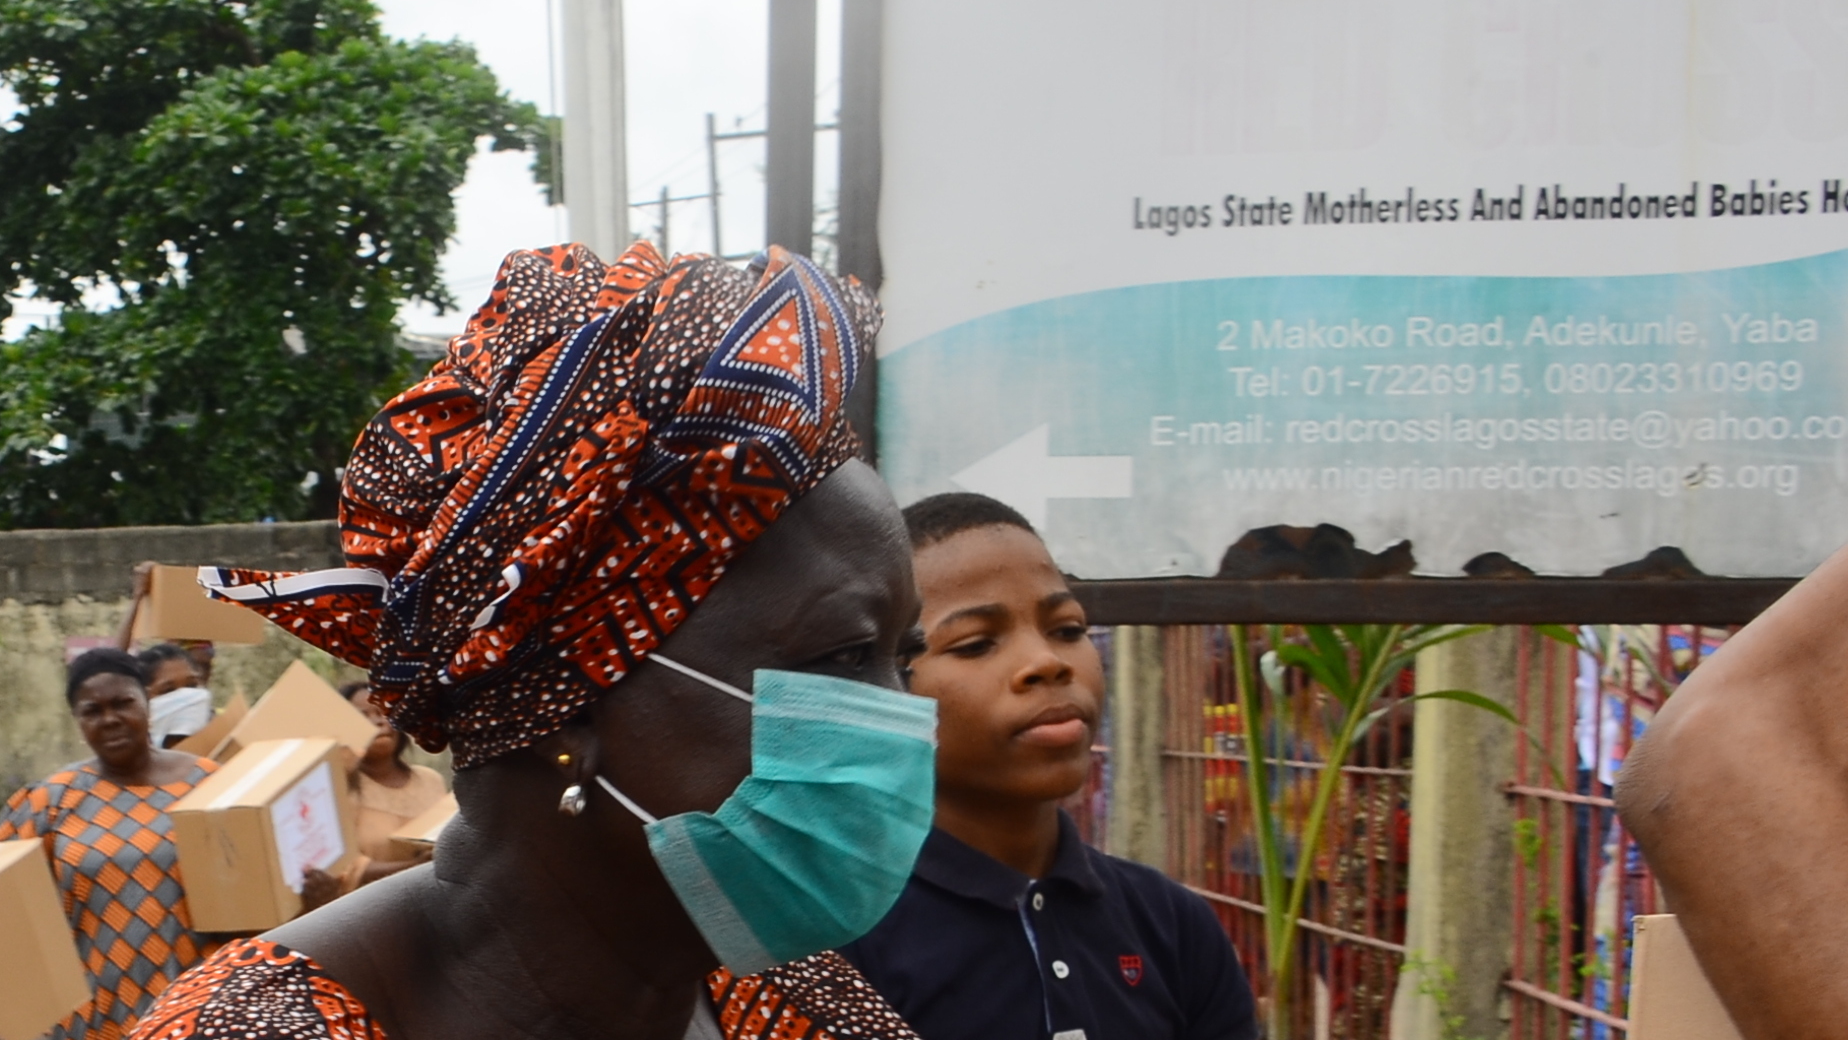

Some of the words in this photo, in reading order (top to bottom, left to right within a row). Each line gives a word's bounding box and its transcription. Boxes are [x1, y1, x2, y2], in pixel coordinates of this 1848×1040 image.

[1133, 195, 1212, 236] Lagos
[1222, 192, 1293, 227] State
[1303, 186, 1459, 225] Motherless
[1470, 183, 1524, 221] And
[1533, 180, 1699, 221] Abandoned
[1709, 177, 1809, 217] Babies
[1822, 179, 1848, 214] H
[1215, 320, 1240, 350] 2
[1251, 317, 1394, 349] Makoko
[1405, 315, 1514, 351] Road,
[1522, 314, 1708, 348] Adekunle,
[1721, 311, 1820, 345] Yaba
[1228, 366, 1291, 397] Tel:
[1302, 362, 1533, 398] 01-7226915,
[1543, 358, 1803, 395] 08023310969
[1151, 412, 1274, 446] E-mail:
